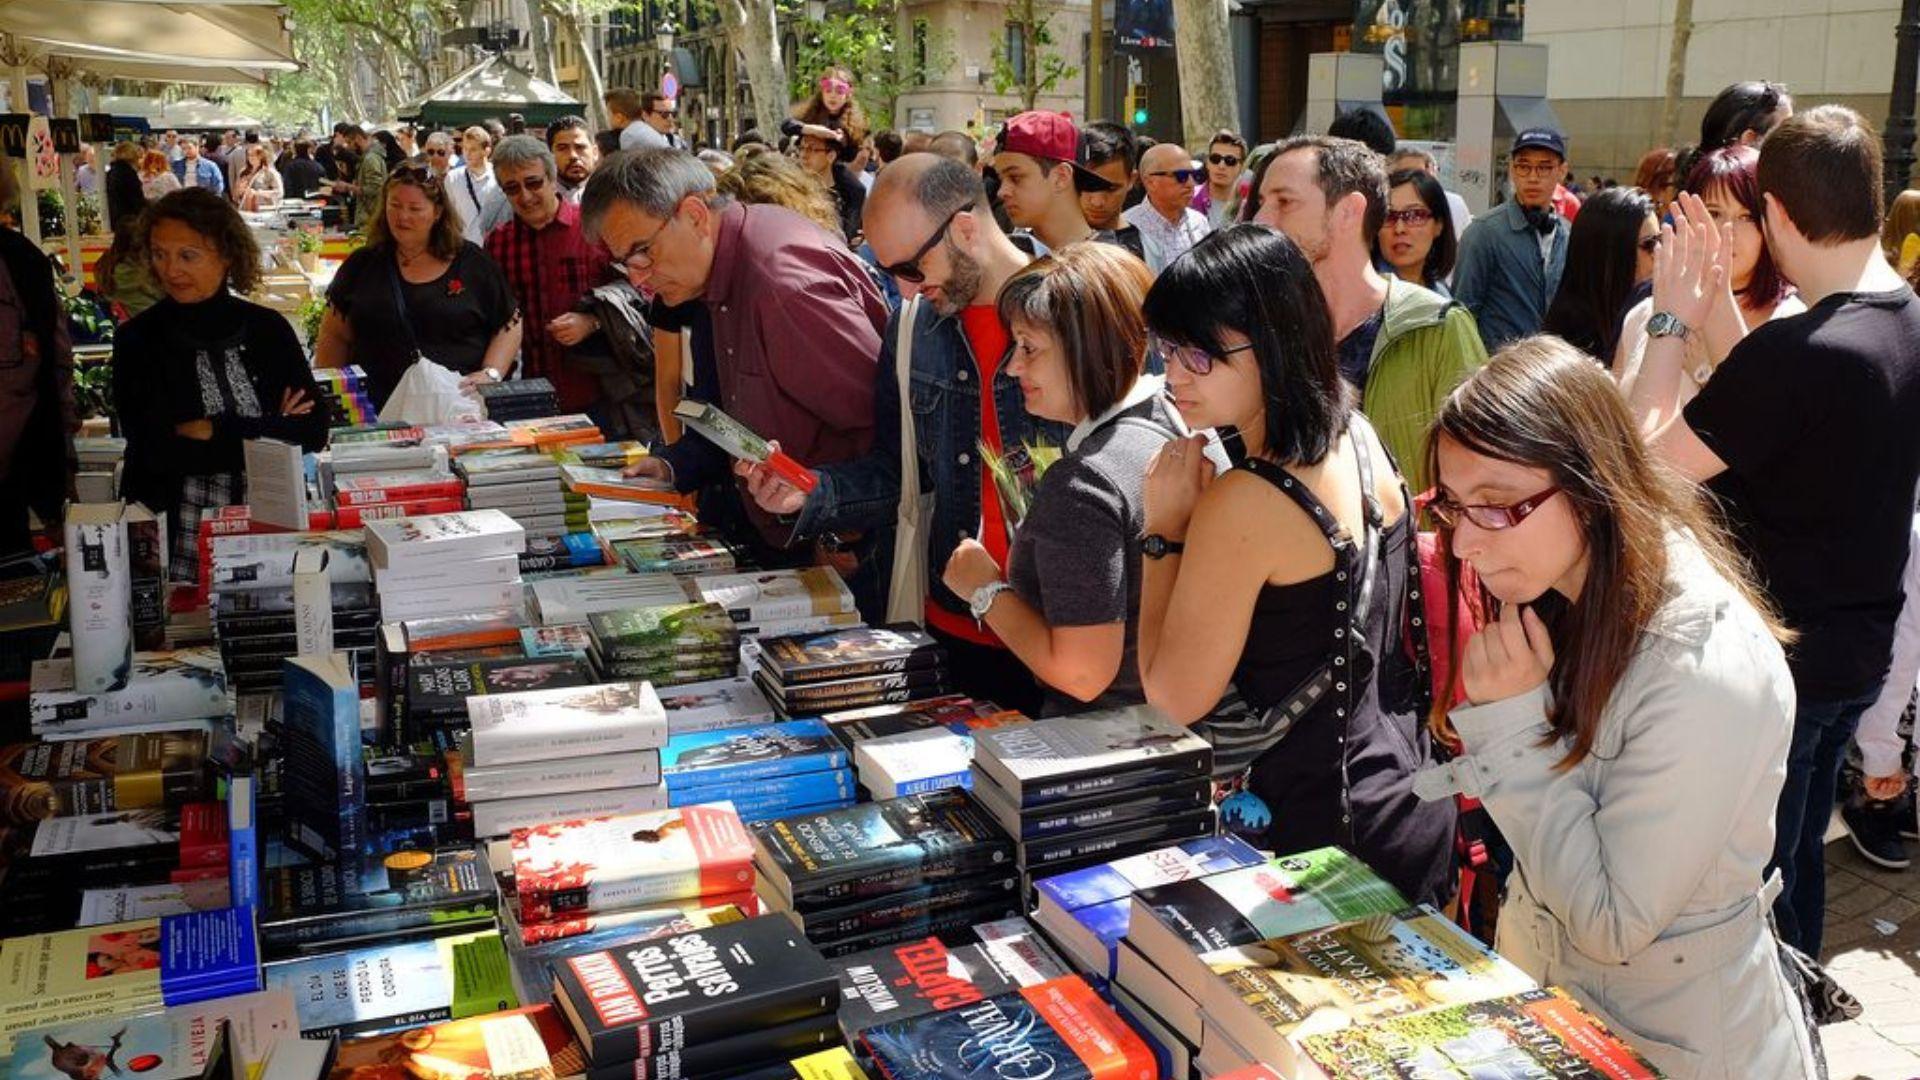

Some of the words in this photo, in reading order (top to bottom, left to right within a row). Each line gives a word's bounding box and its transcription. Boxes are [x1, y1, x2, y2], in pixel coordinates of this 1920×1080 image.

[574, 952, 631, 999] RANKIN
[627, 945, 691, 1006] Perros
[667, 933, 740, 997] salvajes
[311, 989, 324, 1002] EL
[333, 980, 348, 1000] QUE
[846, 964, 900, 1014] WINSLOW
[394, 1017, 406, 1026] EL
[428, 1010, 448, 1020] QUE
[599, 997, 644, 1025] IAN
[190, 1014, 206, 1048] VIEJA
